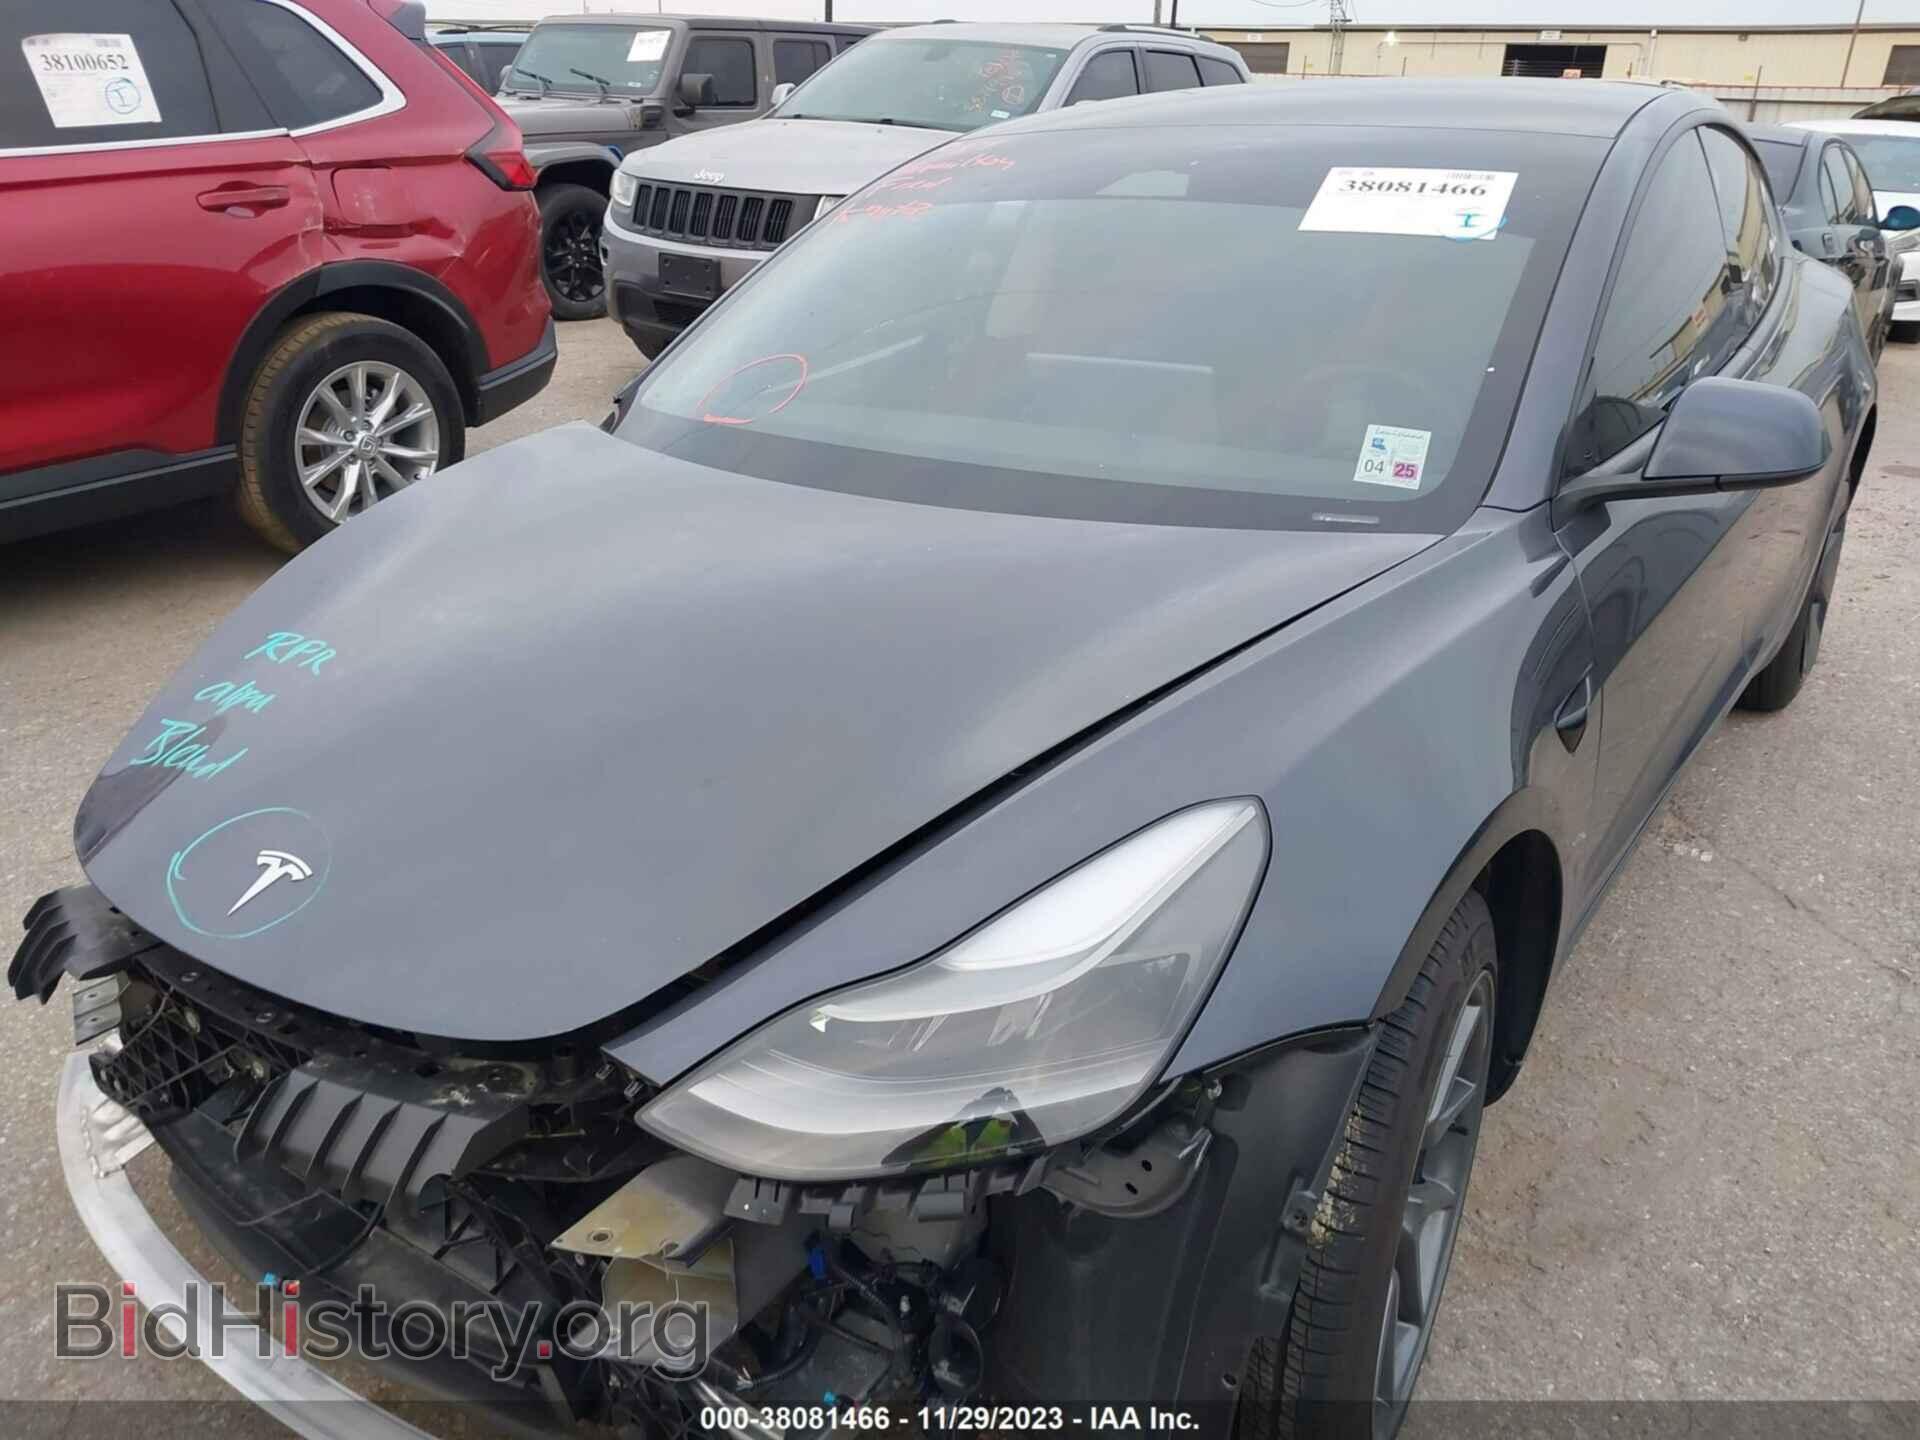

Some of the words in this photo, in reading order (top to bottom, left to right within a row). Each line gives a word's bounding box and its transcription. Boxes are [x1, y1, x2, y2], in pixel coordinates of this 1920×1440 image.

[40, 53, 129, 71] 38100652
[693, 167, 725, 184] Jeep
[1338, 179, 1488, 196] 38081466
[1364, 459, 1385, 474] 04
[1394, 462, 1416, 479] 25
